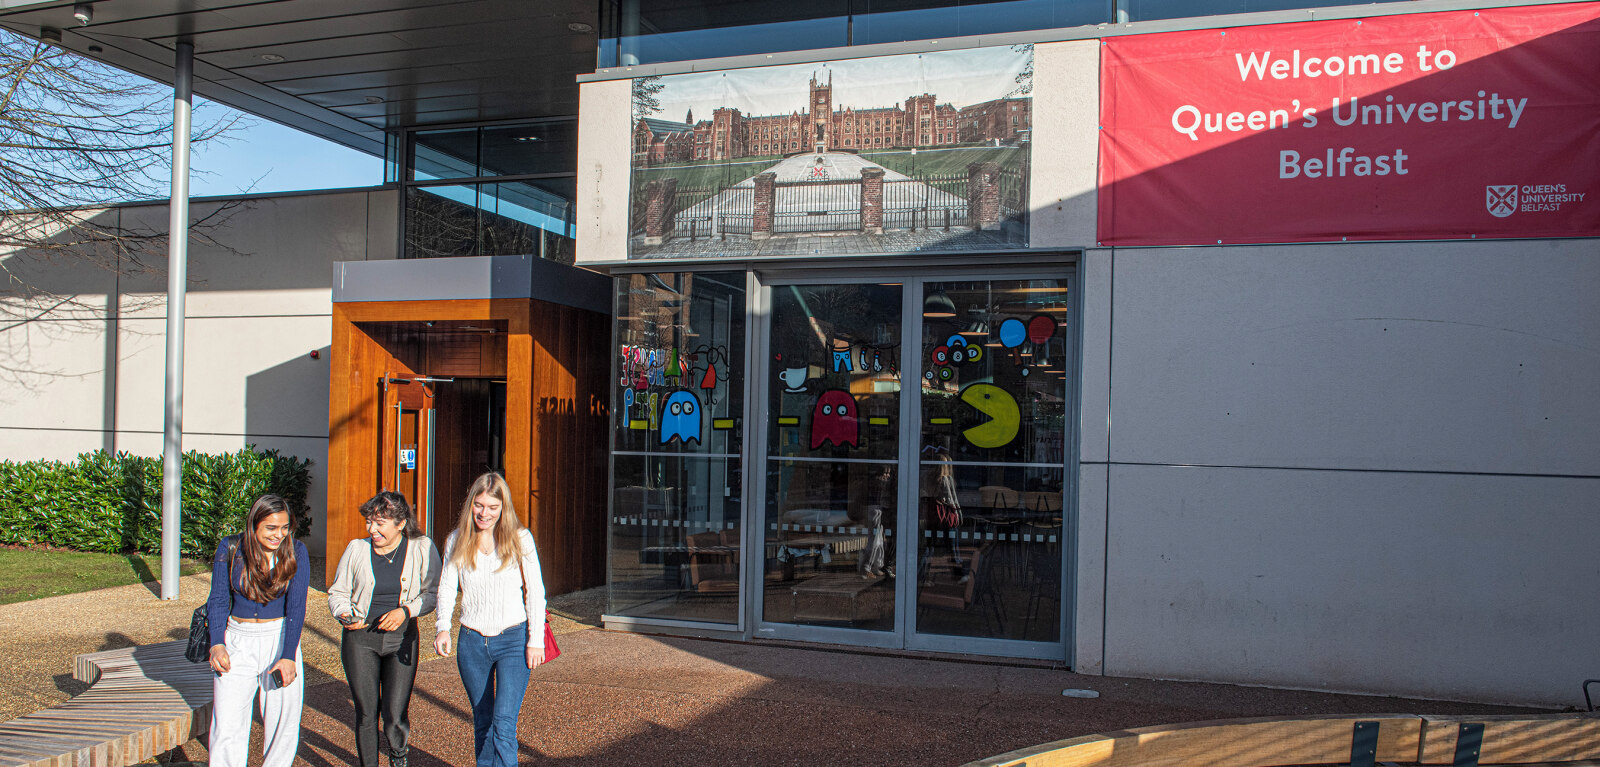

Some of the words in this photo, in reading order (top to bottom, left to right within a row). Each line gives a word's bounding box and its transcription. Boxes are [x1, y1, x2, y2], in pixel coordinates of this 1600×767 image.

[1235, 49, 1404, 81] Welcome
[1416, 45, 1457, 72] to
[1171, 99, 1318, 141] Queen's
[1332, 90, 1528, 128] University
[1279, 147, 1409, 179] Belfast
[1521, 184, 1566, 194] QUEEN'S
[1521, 193, 1585, 203] UNIVERSITY
[1521, 203, 1561, 212] BELFAST
